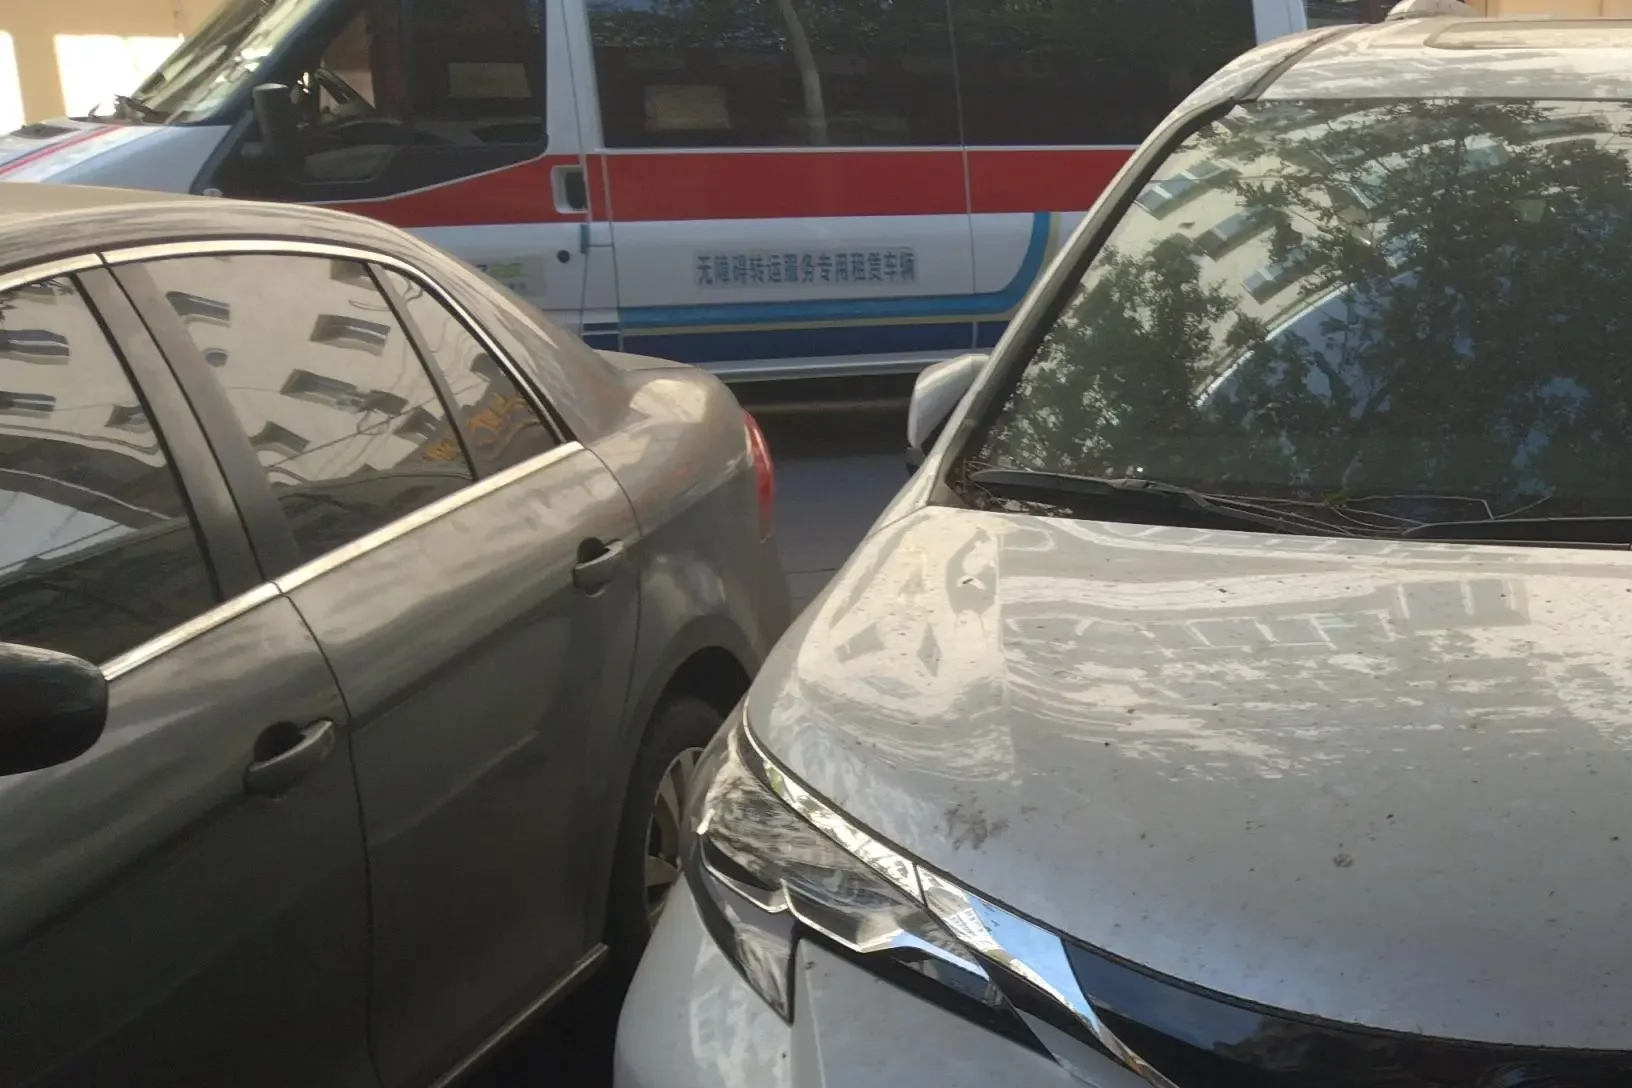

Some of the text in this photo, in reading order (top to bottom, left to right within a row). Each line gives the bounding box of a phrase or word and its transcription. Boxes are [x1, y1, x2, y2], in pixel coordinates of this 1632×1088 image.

[696, 252, 915, 285] 无障碍转运服务专用租赁车辆
